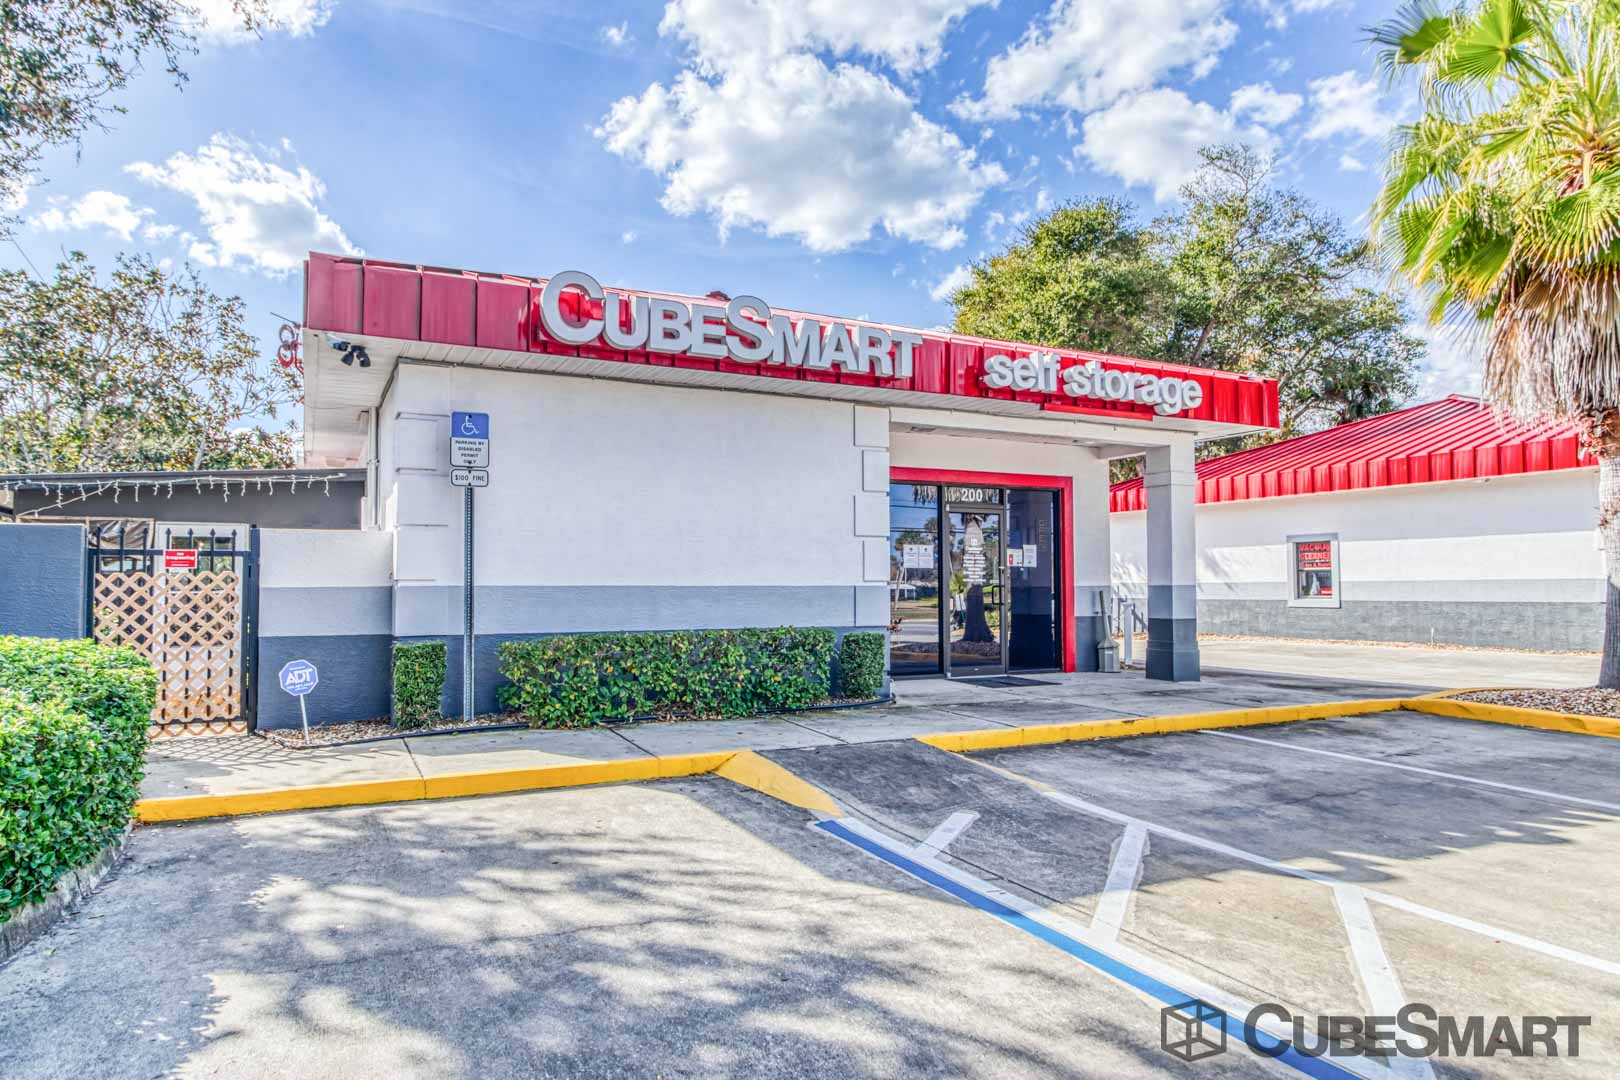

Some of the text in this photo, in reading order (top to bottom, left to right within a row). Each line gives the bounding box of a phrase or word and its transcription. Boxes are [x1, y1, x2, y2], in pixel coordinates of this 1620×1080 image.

[983, 351, 1203, 416] self storage
[961, 488, 983, 502] 200
[285, 669, 313, 685] ADT
